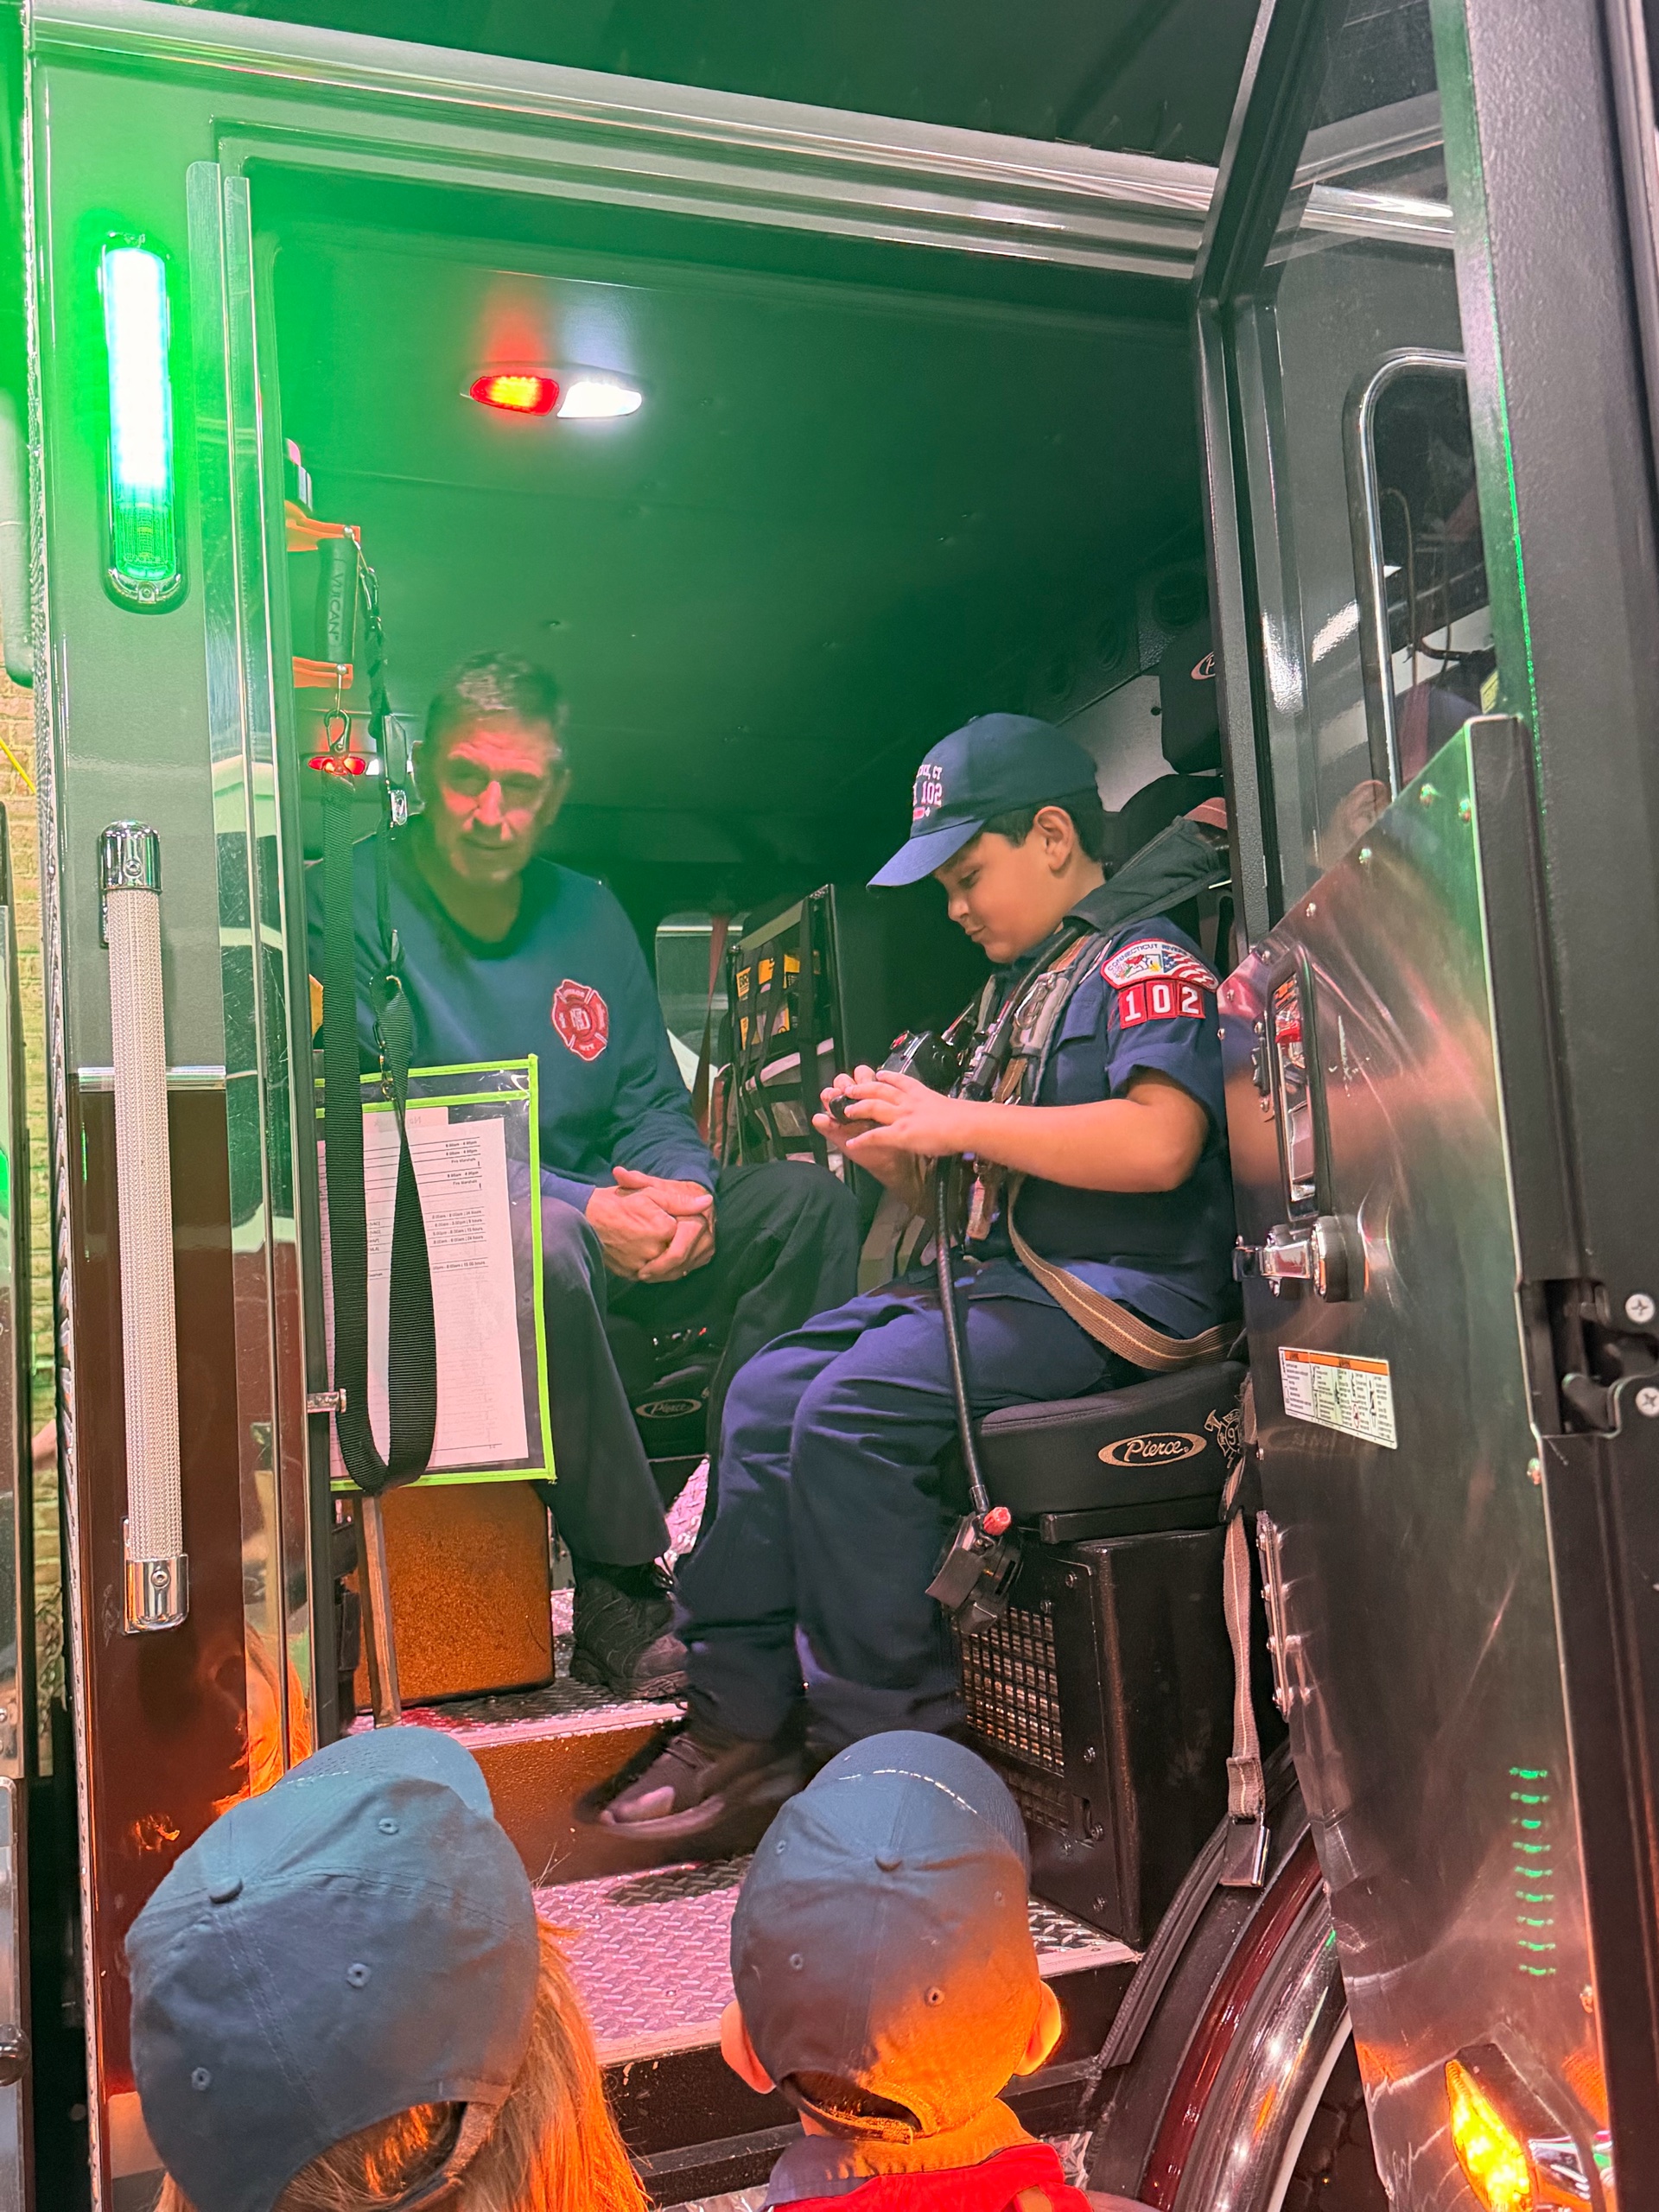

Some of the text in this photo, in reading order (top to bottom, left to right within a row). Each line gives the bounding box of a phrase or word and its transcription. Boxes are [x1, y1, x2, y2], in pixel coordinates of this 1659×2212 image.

[921, 781, 942, 807] 102
[1107, 943, 1158, 971] CONNECTICUT
[1124, 984, 1199, 1022] 102
[1124, 1440, 1183, 1462] Pierce
